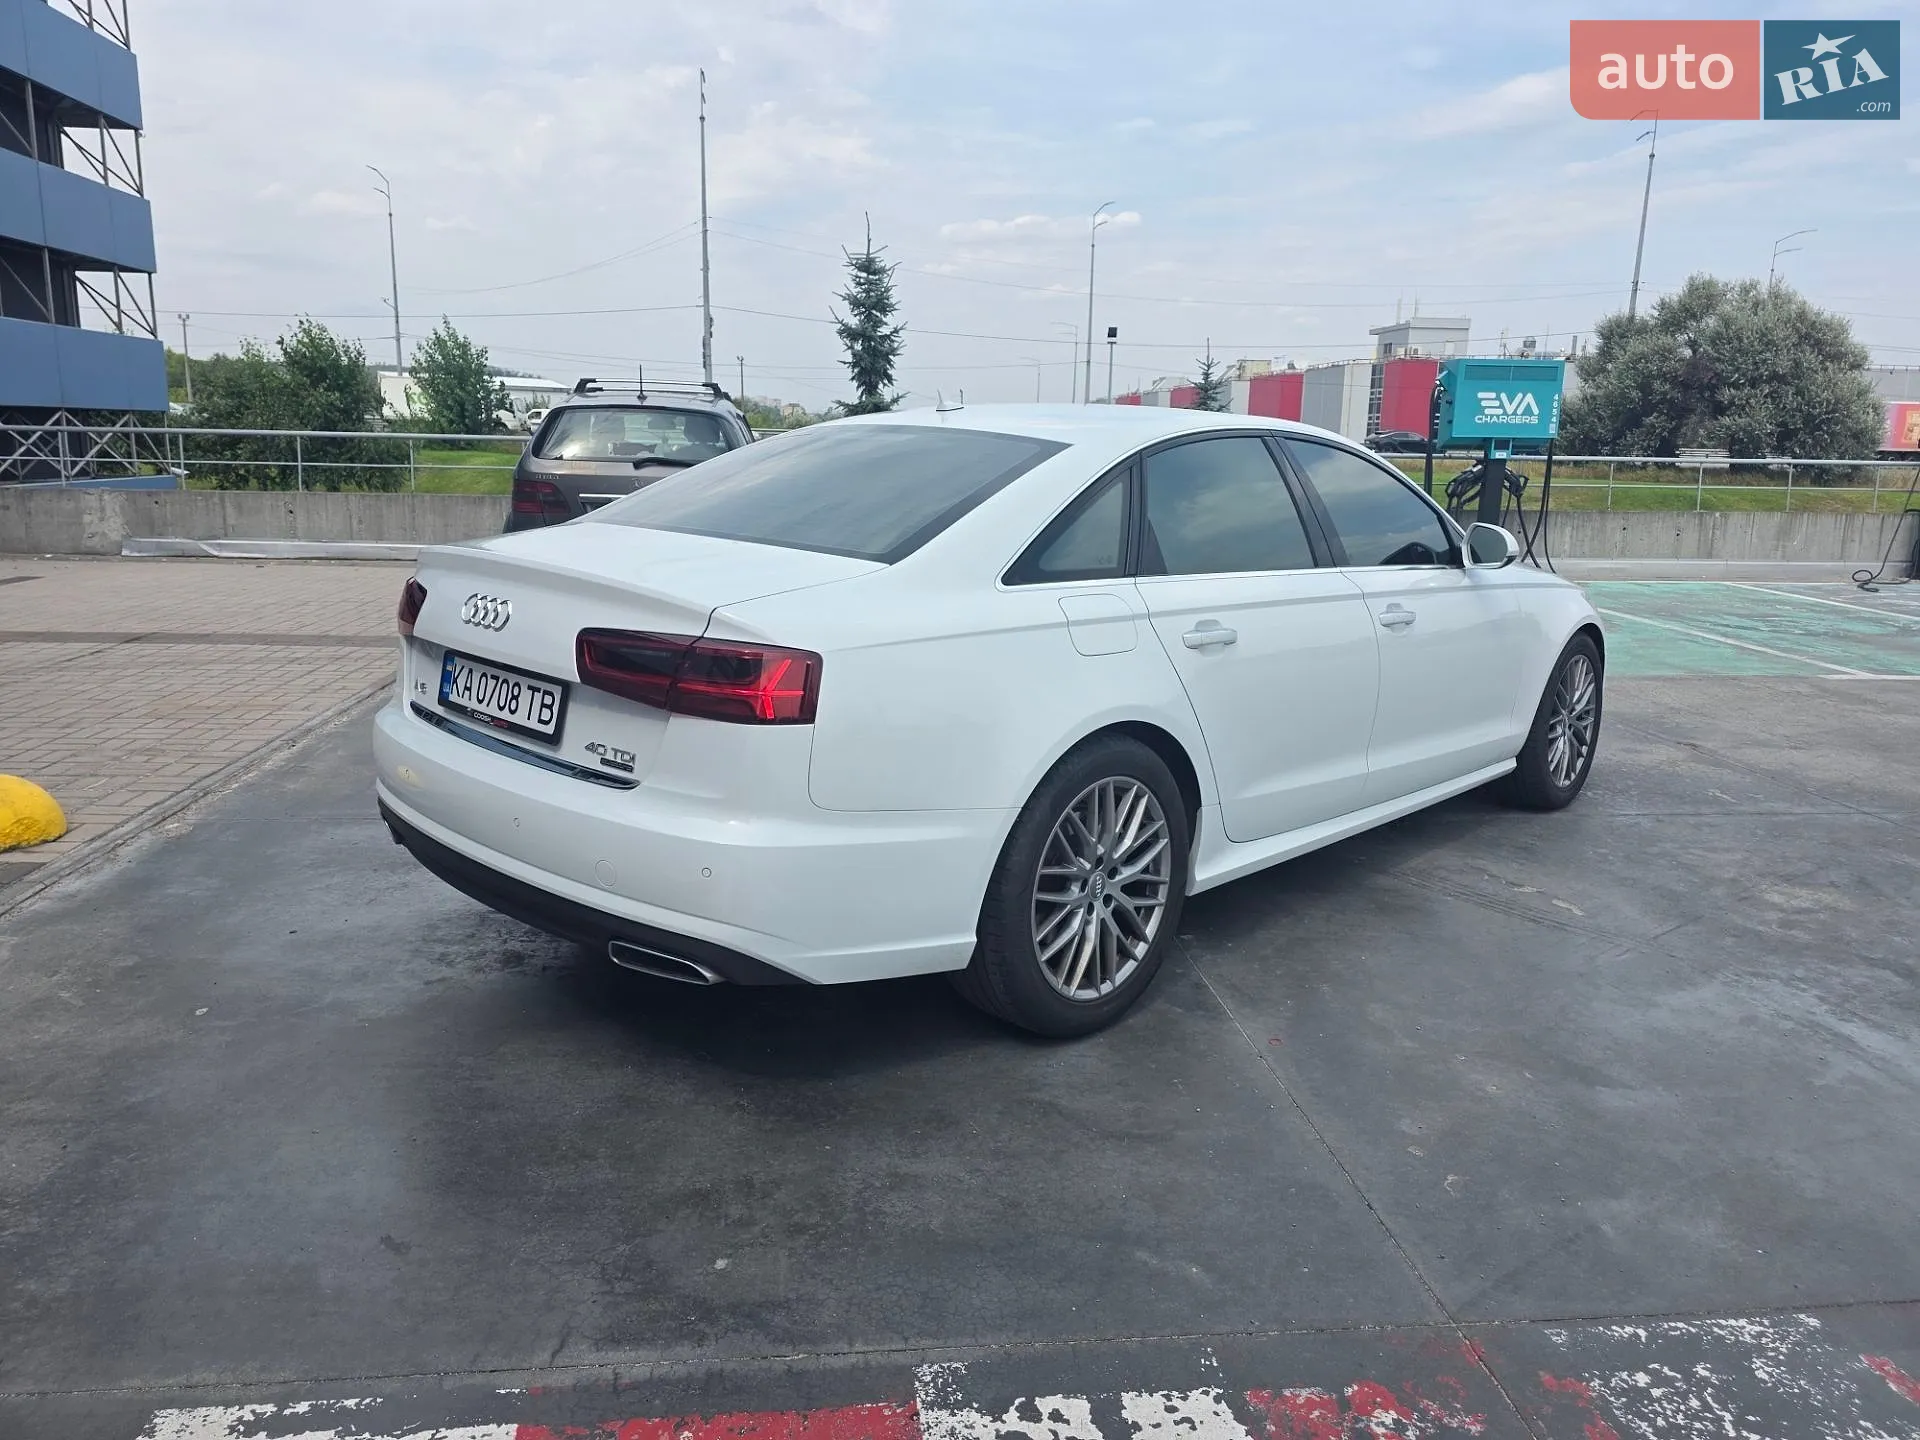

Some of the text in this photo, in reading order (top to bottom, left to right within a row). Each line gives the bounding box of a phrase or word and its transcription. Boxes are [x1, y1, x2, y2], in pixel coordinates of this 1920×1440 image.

[1477, 392, 1539, 415] EVA
[1474, 415, 1539, 424] CHARGERS
[450, 663, 556, 726] KA 0708 TB
[584, 741, 608, 757] 40
[610, 747, 637, 766] TDI
